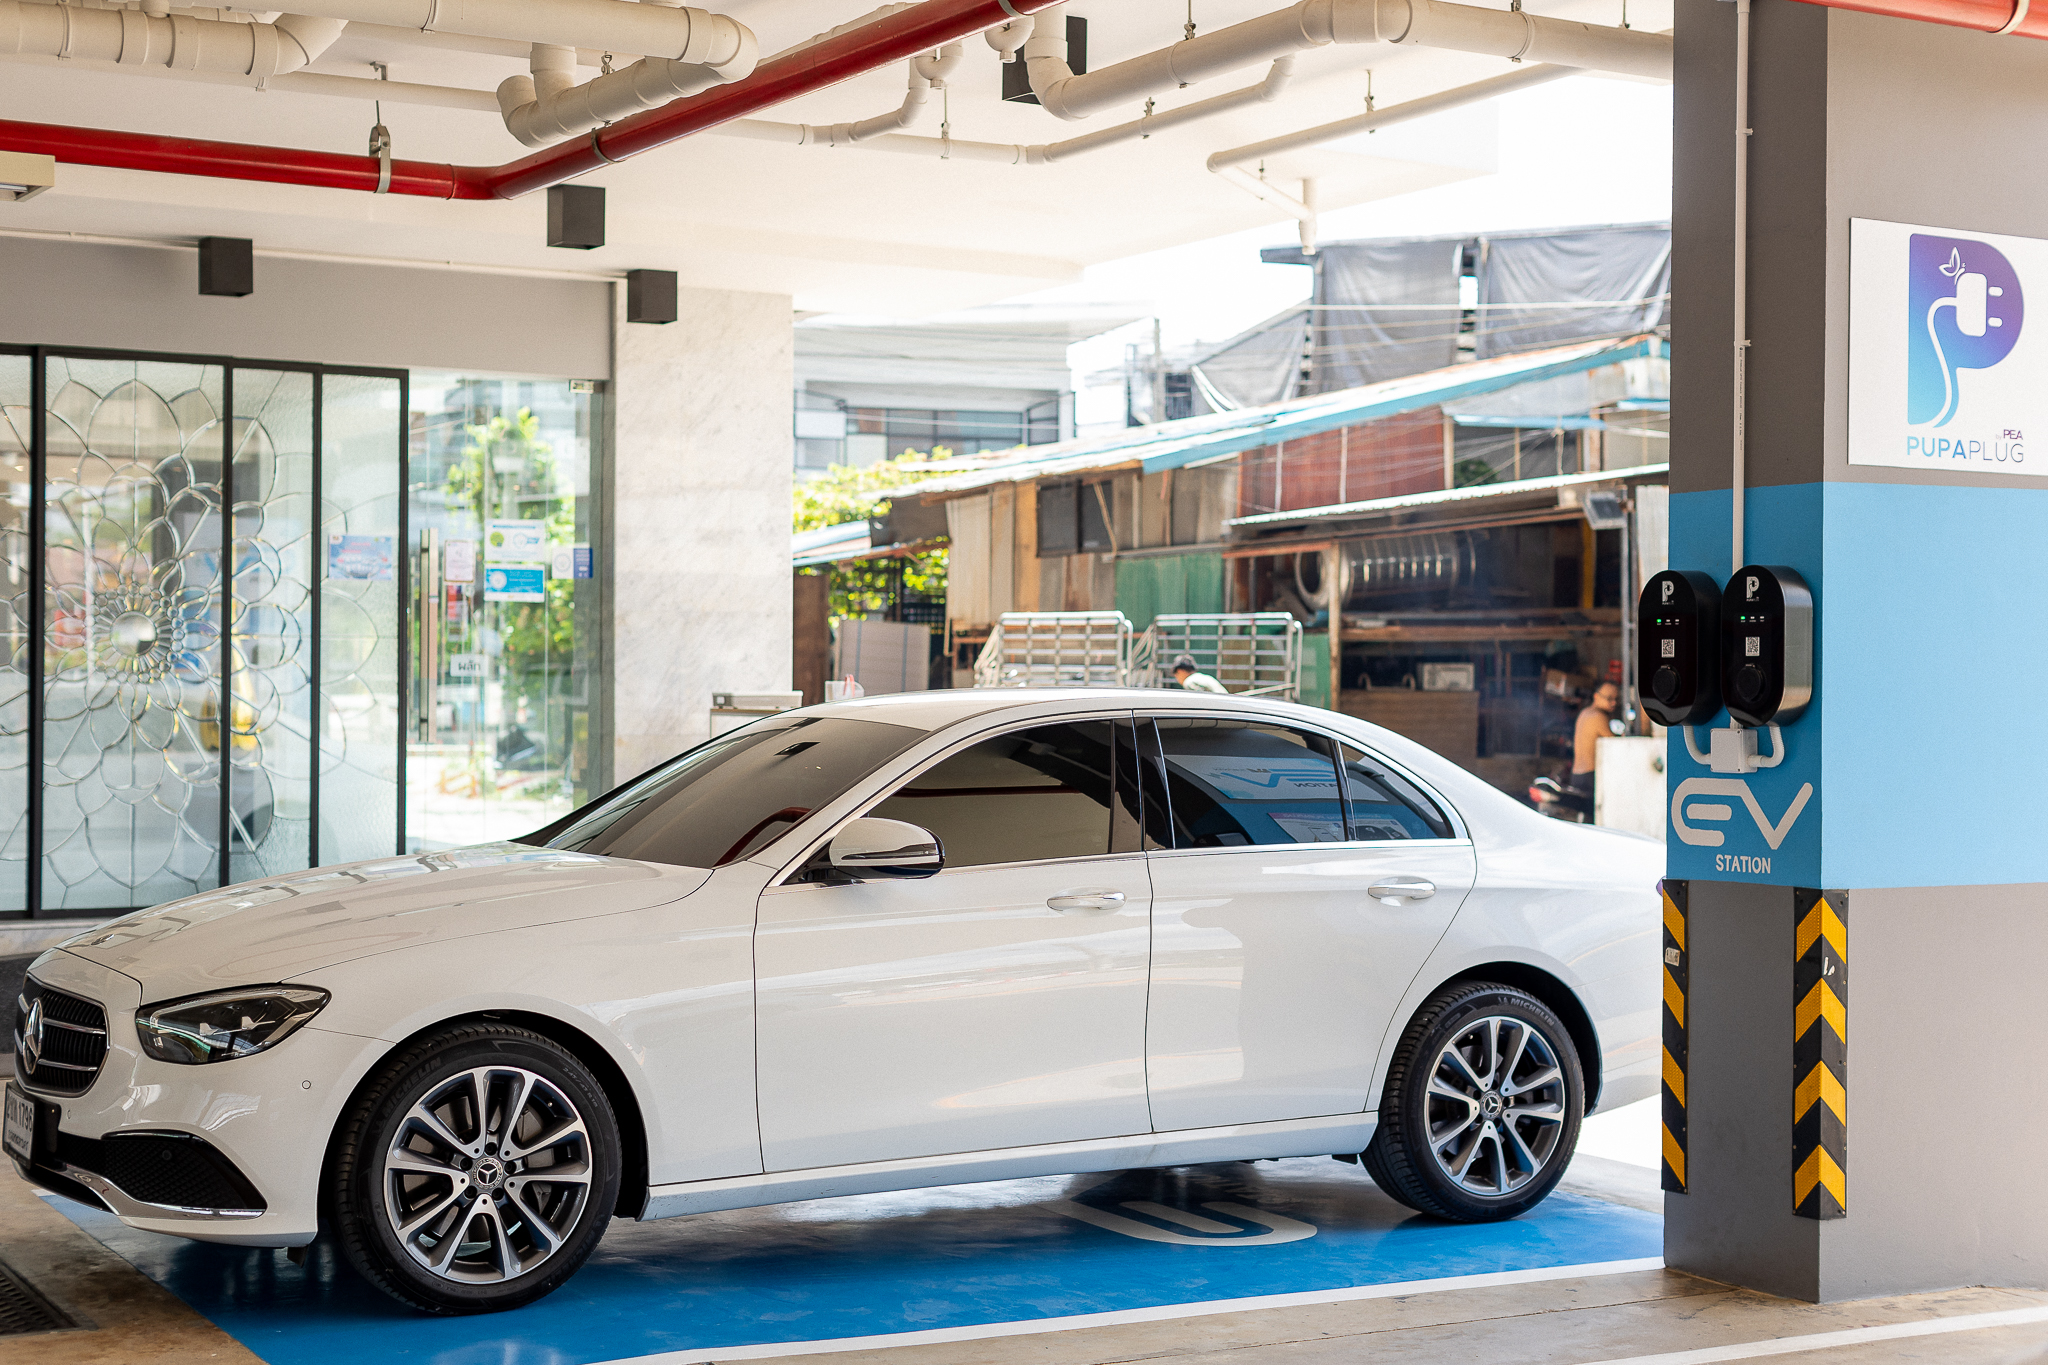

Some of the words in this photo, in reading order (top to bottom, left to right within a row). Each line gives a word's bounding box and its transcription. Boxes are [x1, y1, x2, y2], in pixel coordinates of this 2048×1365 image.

[2003, 429, 2023, 440] PEA
[1906, 435, 2024, 463] PUPAPLUG
[458, 660, 481, 671] ผลัก
[1671, 777, 1813, 850] EV
[1715, 854, 1771, 875] STATION
[1511, 997, 1555, 1027] MICHELIN
[381, 1057, 442, 1118] MICHELIN
